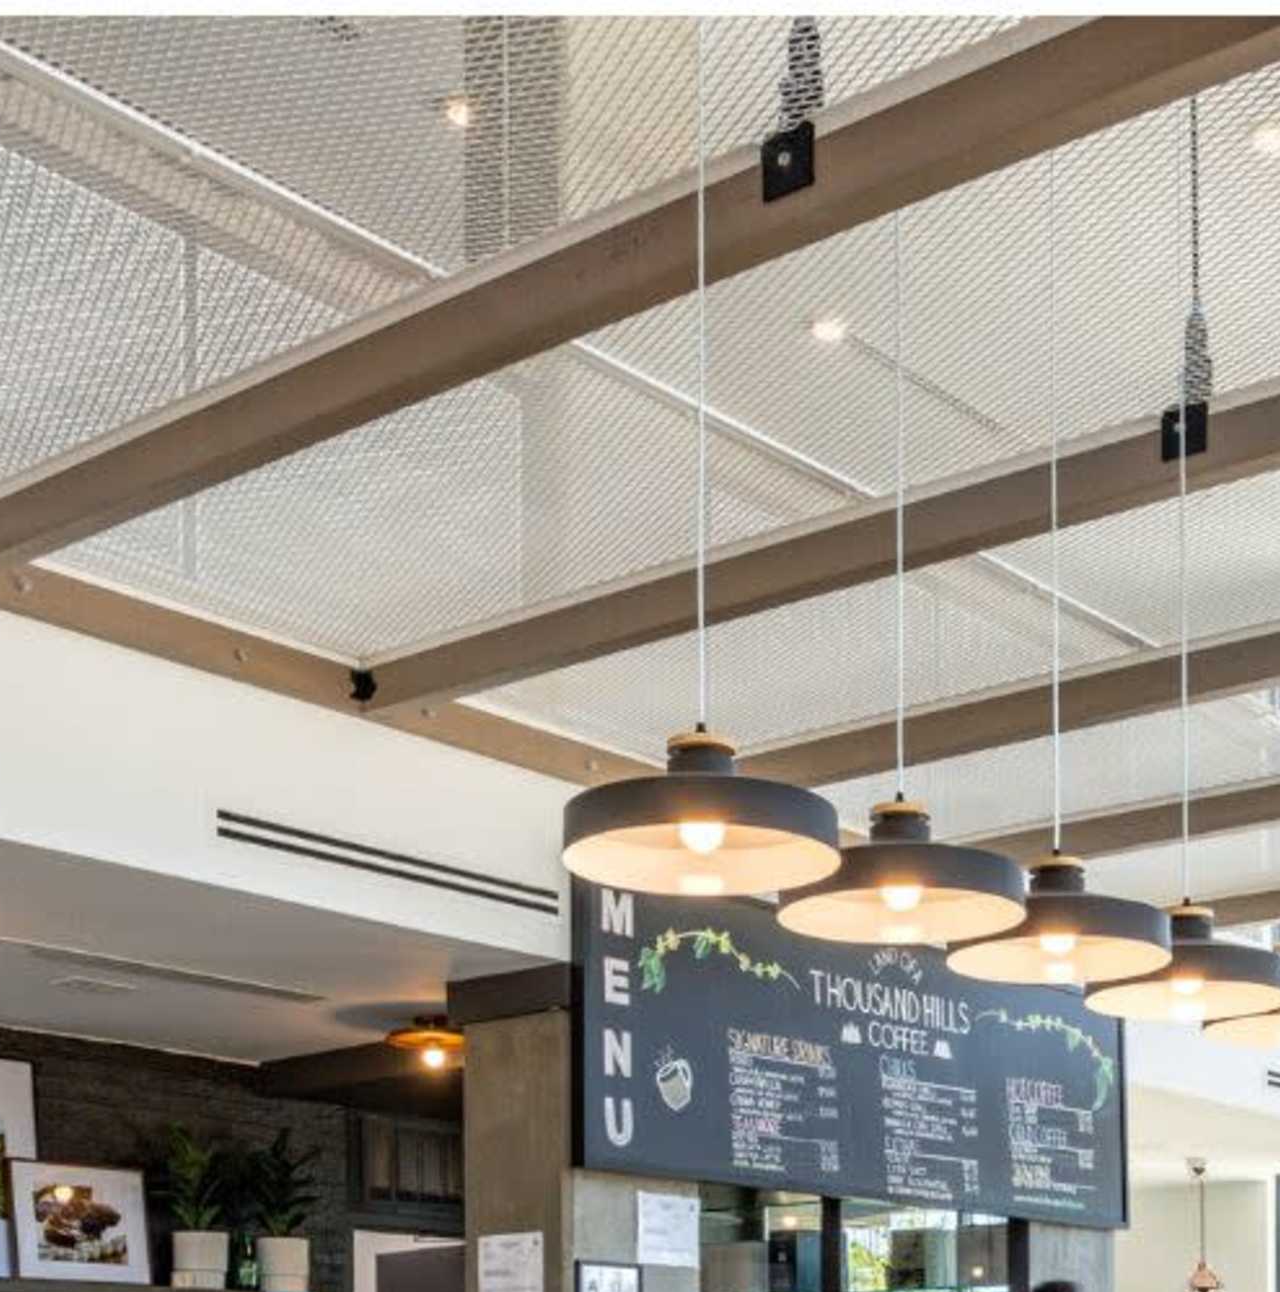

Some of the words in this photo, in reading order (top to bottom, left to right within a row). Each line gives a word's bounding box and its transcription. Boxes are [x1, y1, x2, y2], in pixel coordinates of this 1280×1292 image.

[601, 887, 634, 1147] MENU
[809, 969, 920, 1024] THOUSAND
[923, 994, 971, 1034] HILLS
[868, 1020, 929, 1055] COFFEE
